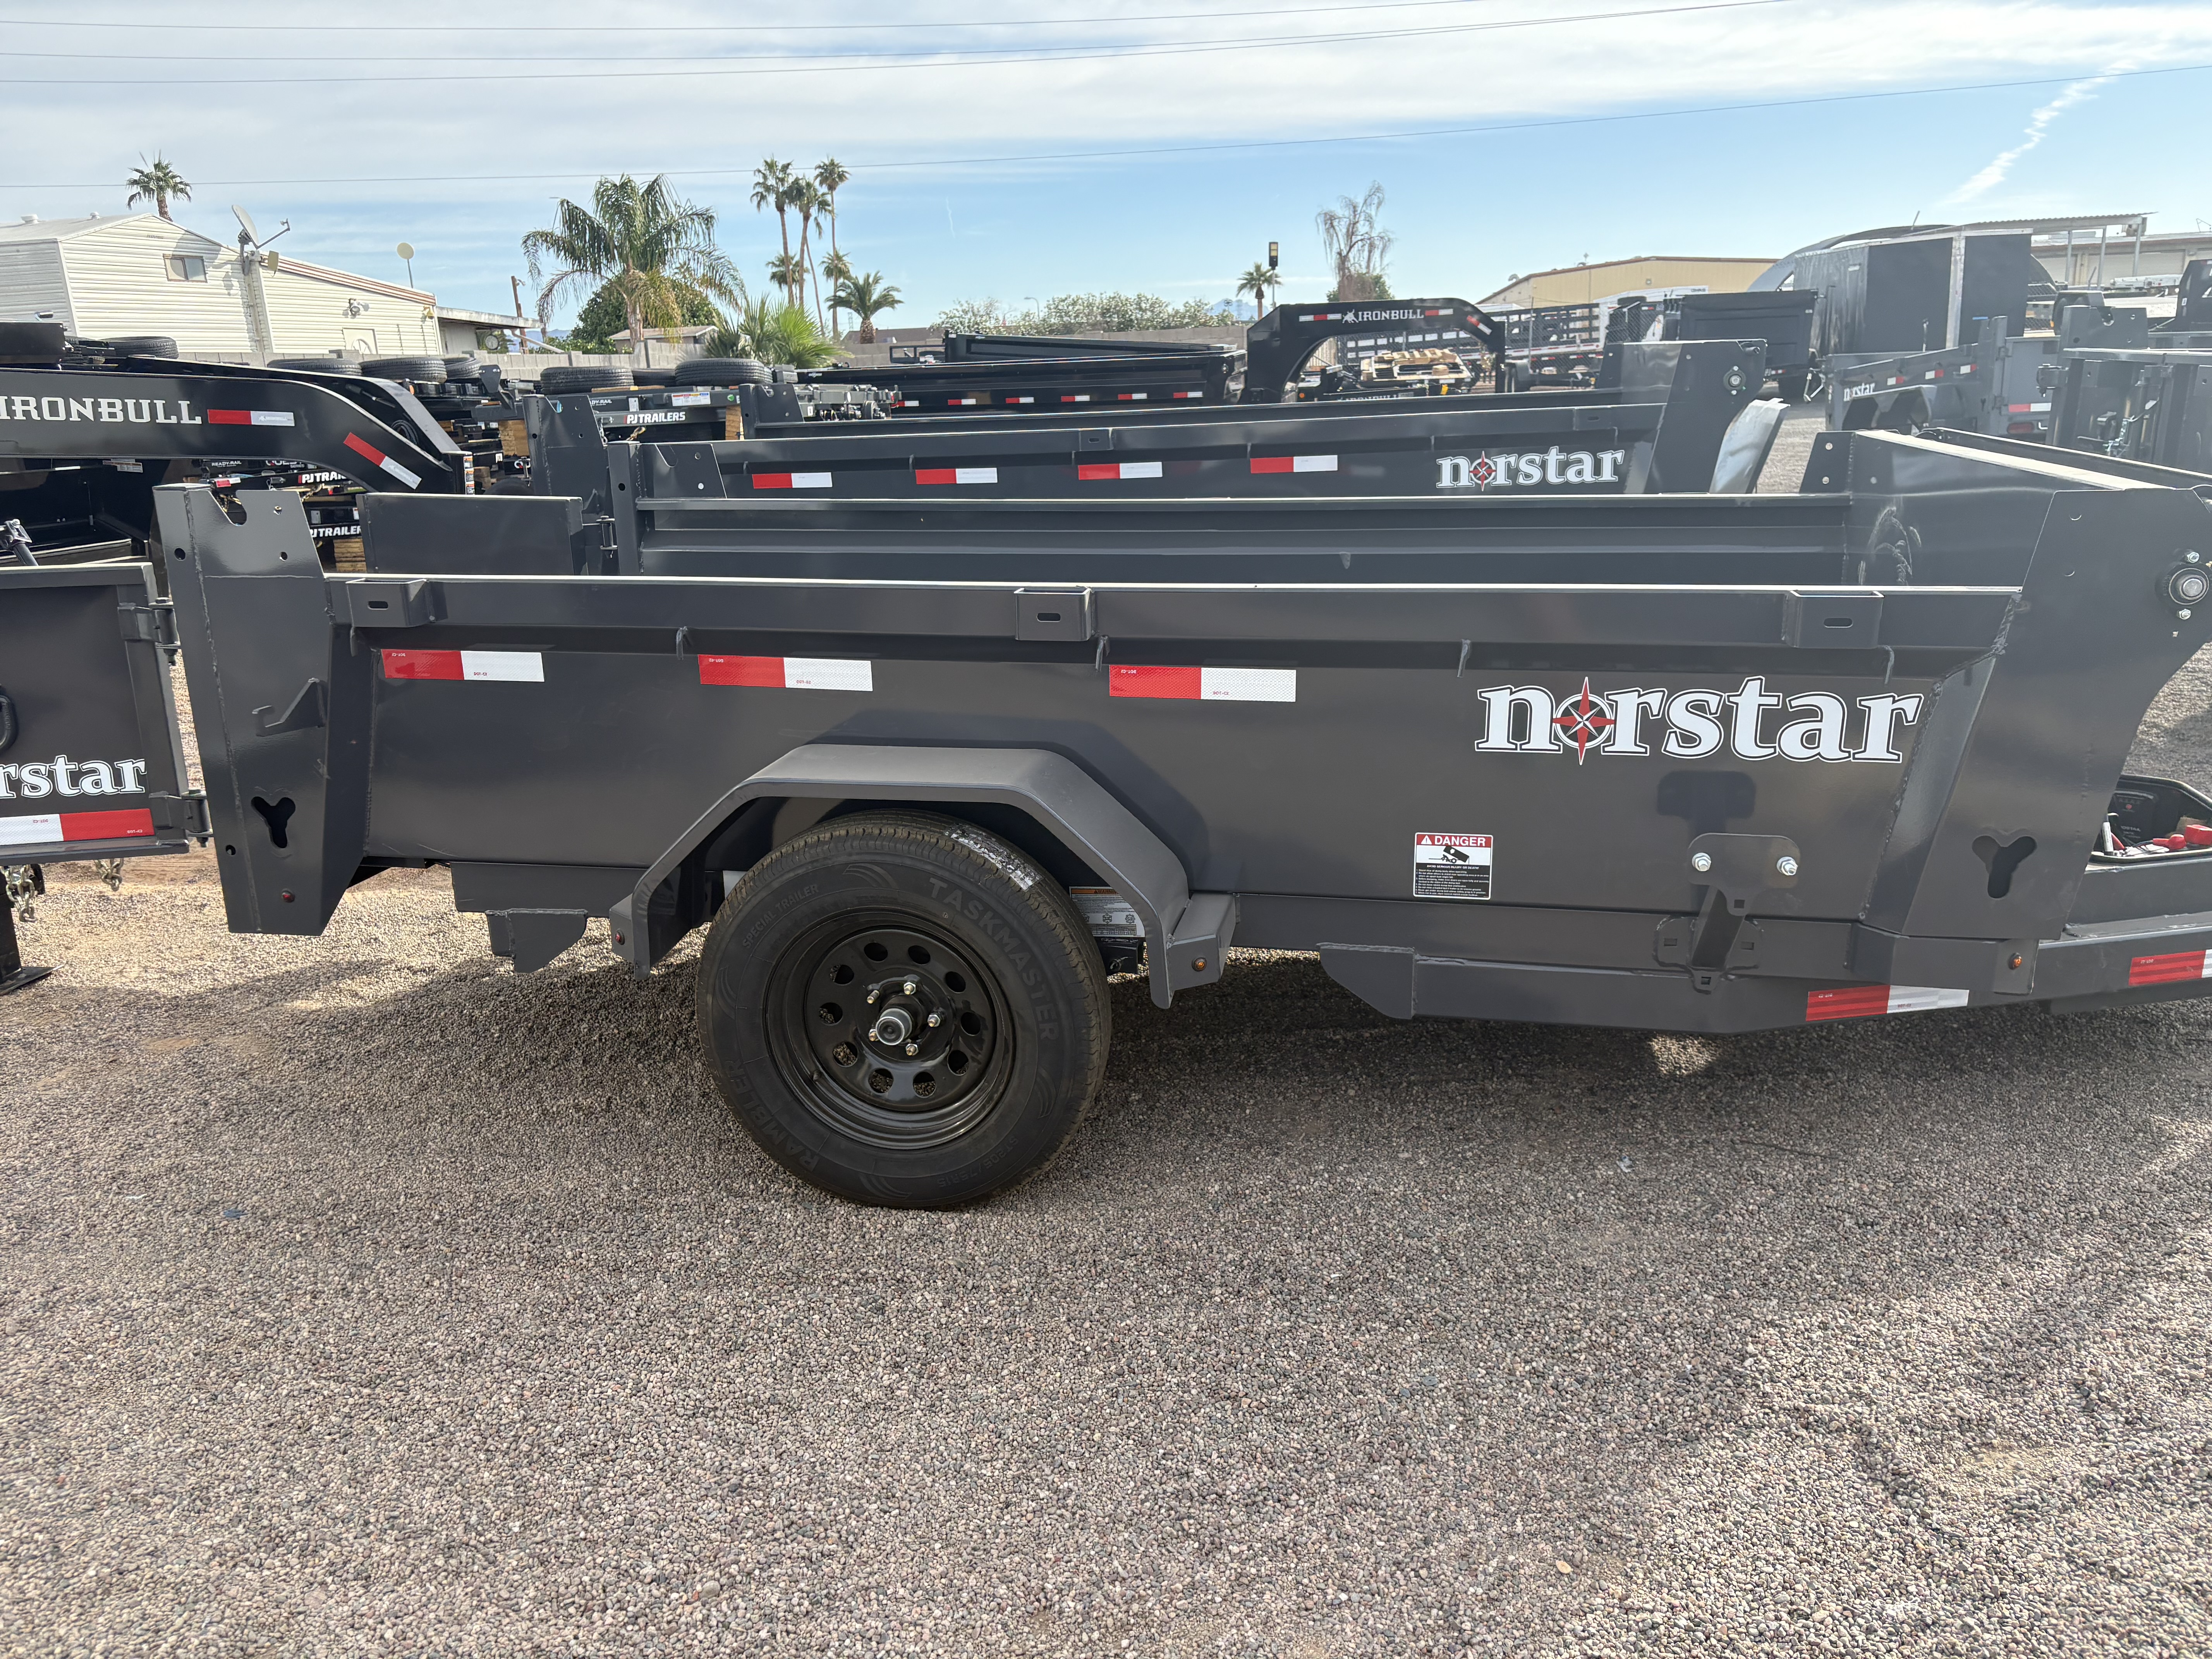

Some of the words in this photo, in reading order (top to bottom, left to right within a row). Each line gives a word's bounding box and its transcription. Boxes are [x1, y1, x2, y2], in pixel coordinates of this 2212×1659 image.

[1358, 309, 1424, 321] IRONBULL
[0, 396, 202, 424] IRONBULL
[638, 412, 685, 424] TRAILERS
[1436, 446, 1625, 491] norstar
[1475, 676, 1924, 765] norstar
[1435, 835, 1486, 847] DANGER
[775, 884, 819, 911] TRAILER
[929, 878, 1060, 1041] TASKMASTER
